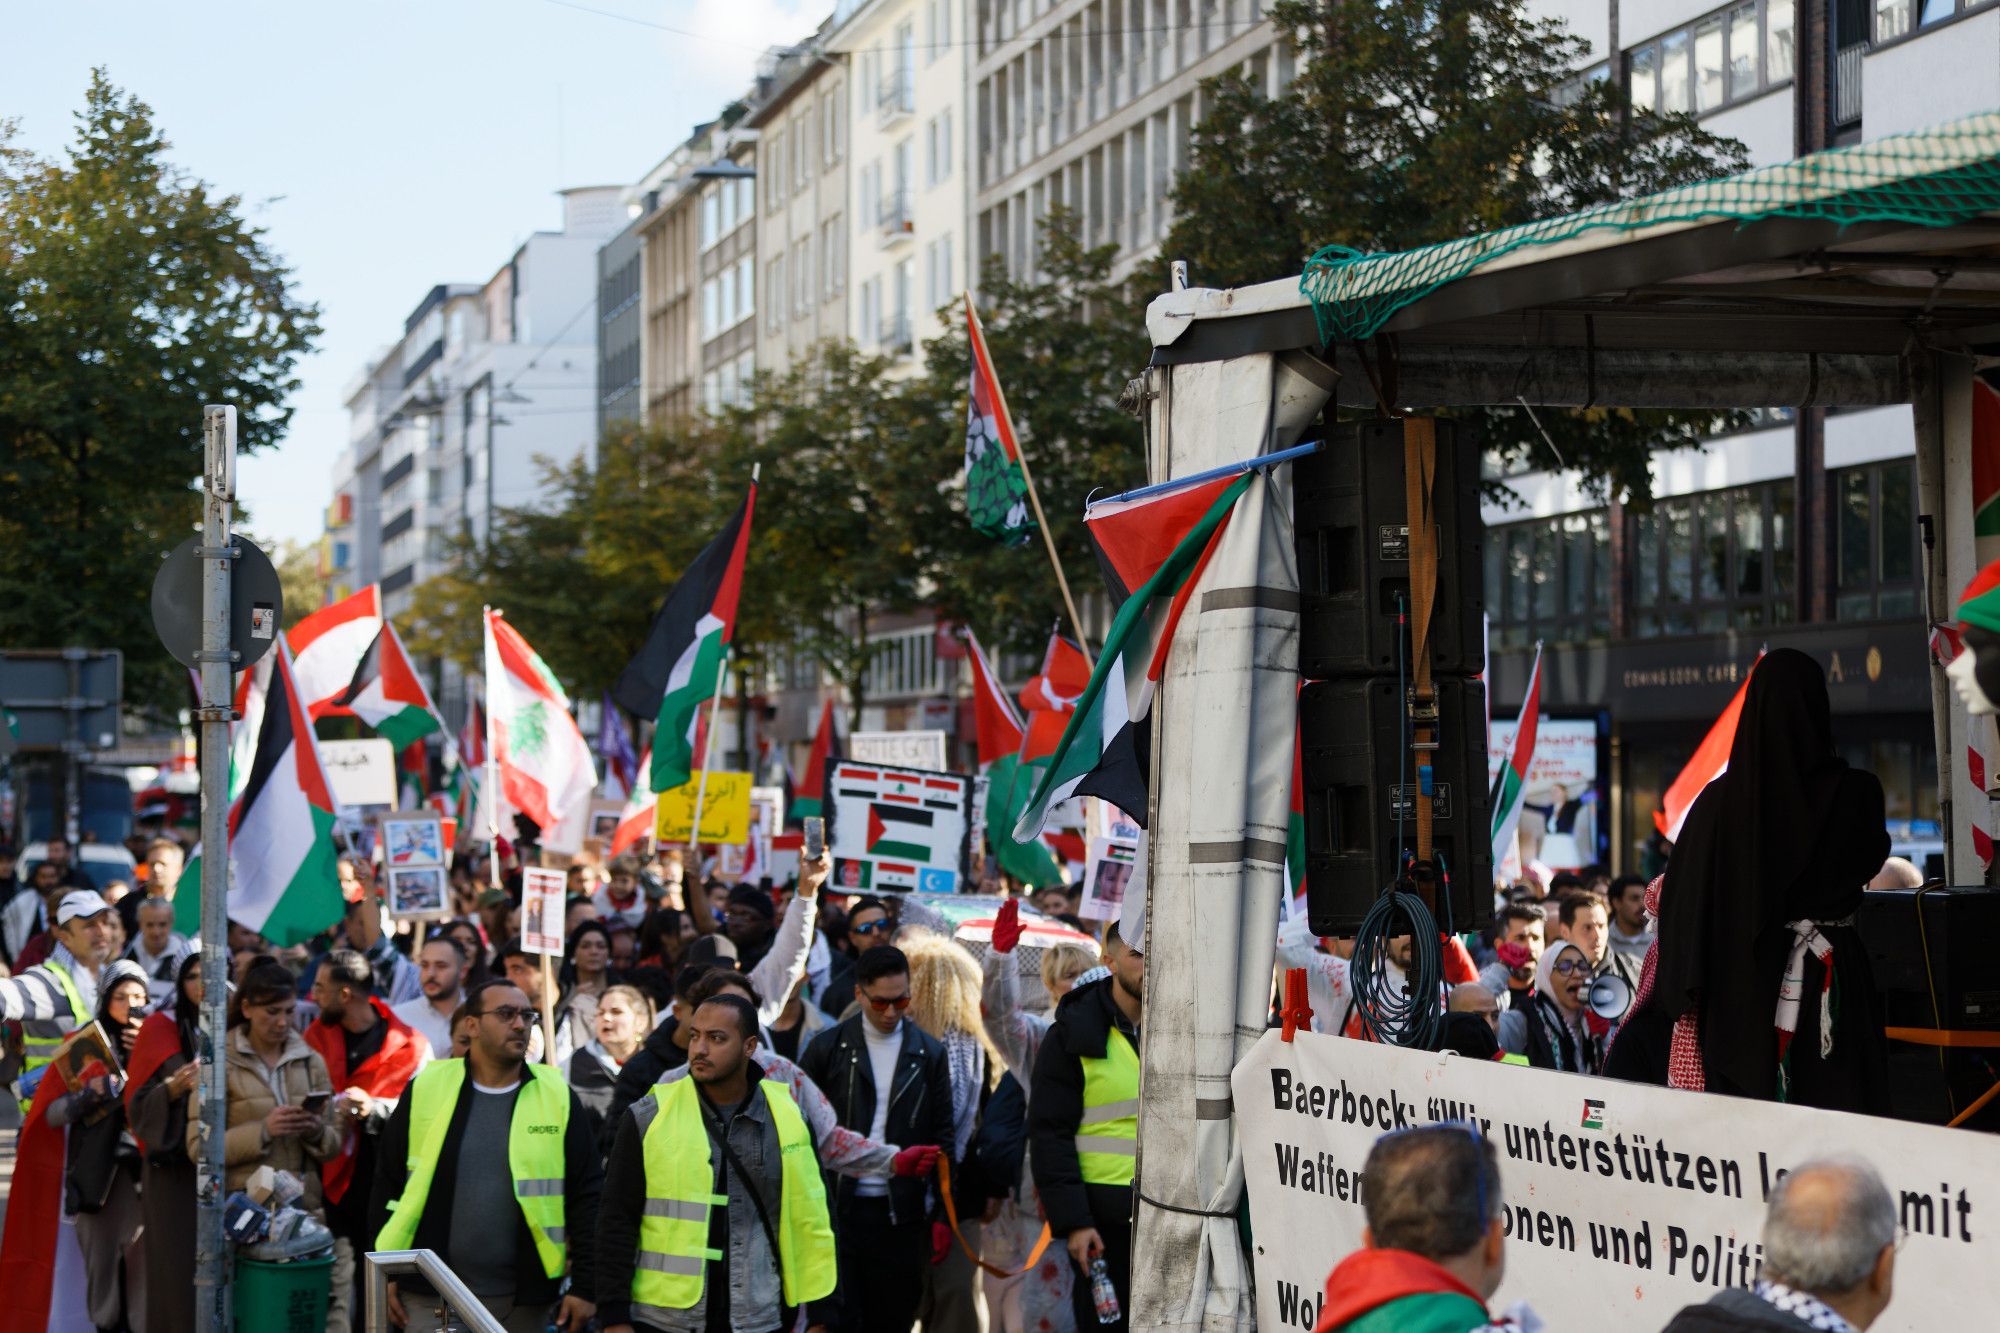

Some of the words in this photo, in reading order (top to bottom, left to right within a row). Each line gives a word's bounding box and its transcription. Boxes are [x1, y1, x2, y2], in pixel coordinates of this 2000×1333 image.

[1271, 1068, 1416, 1130] Baerbock:
[1504, 1120, 1742, 1198] unterstützen
[1900, 1182, 1972, 1243] mit
[1503, 1202, 1575, 1252] onen
[1589, 1220, 1652, 1270] und
[1667, 1225, 1763, 1292] Politi
